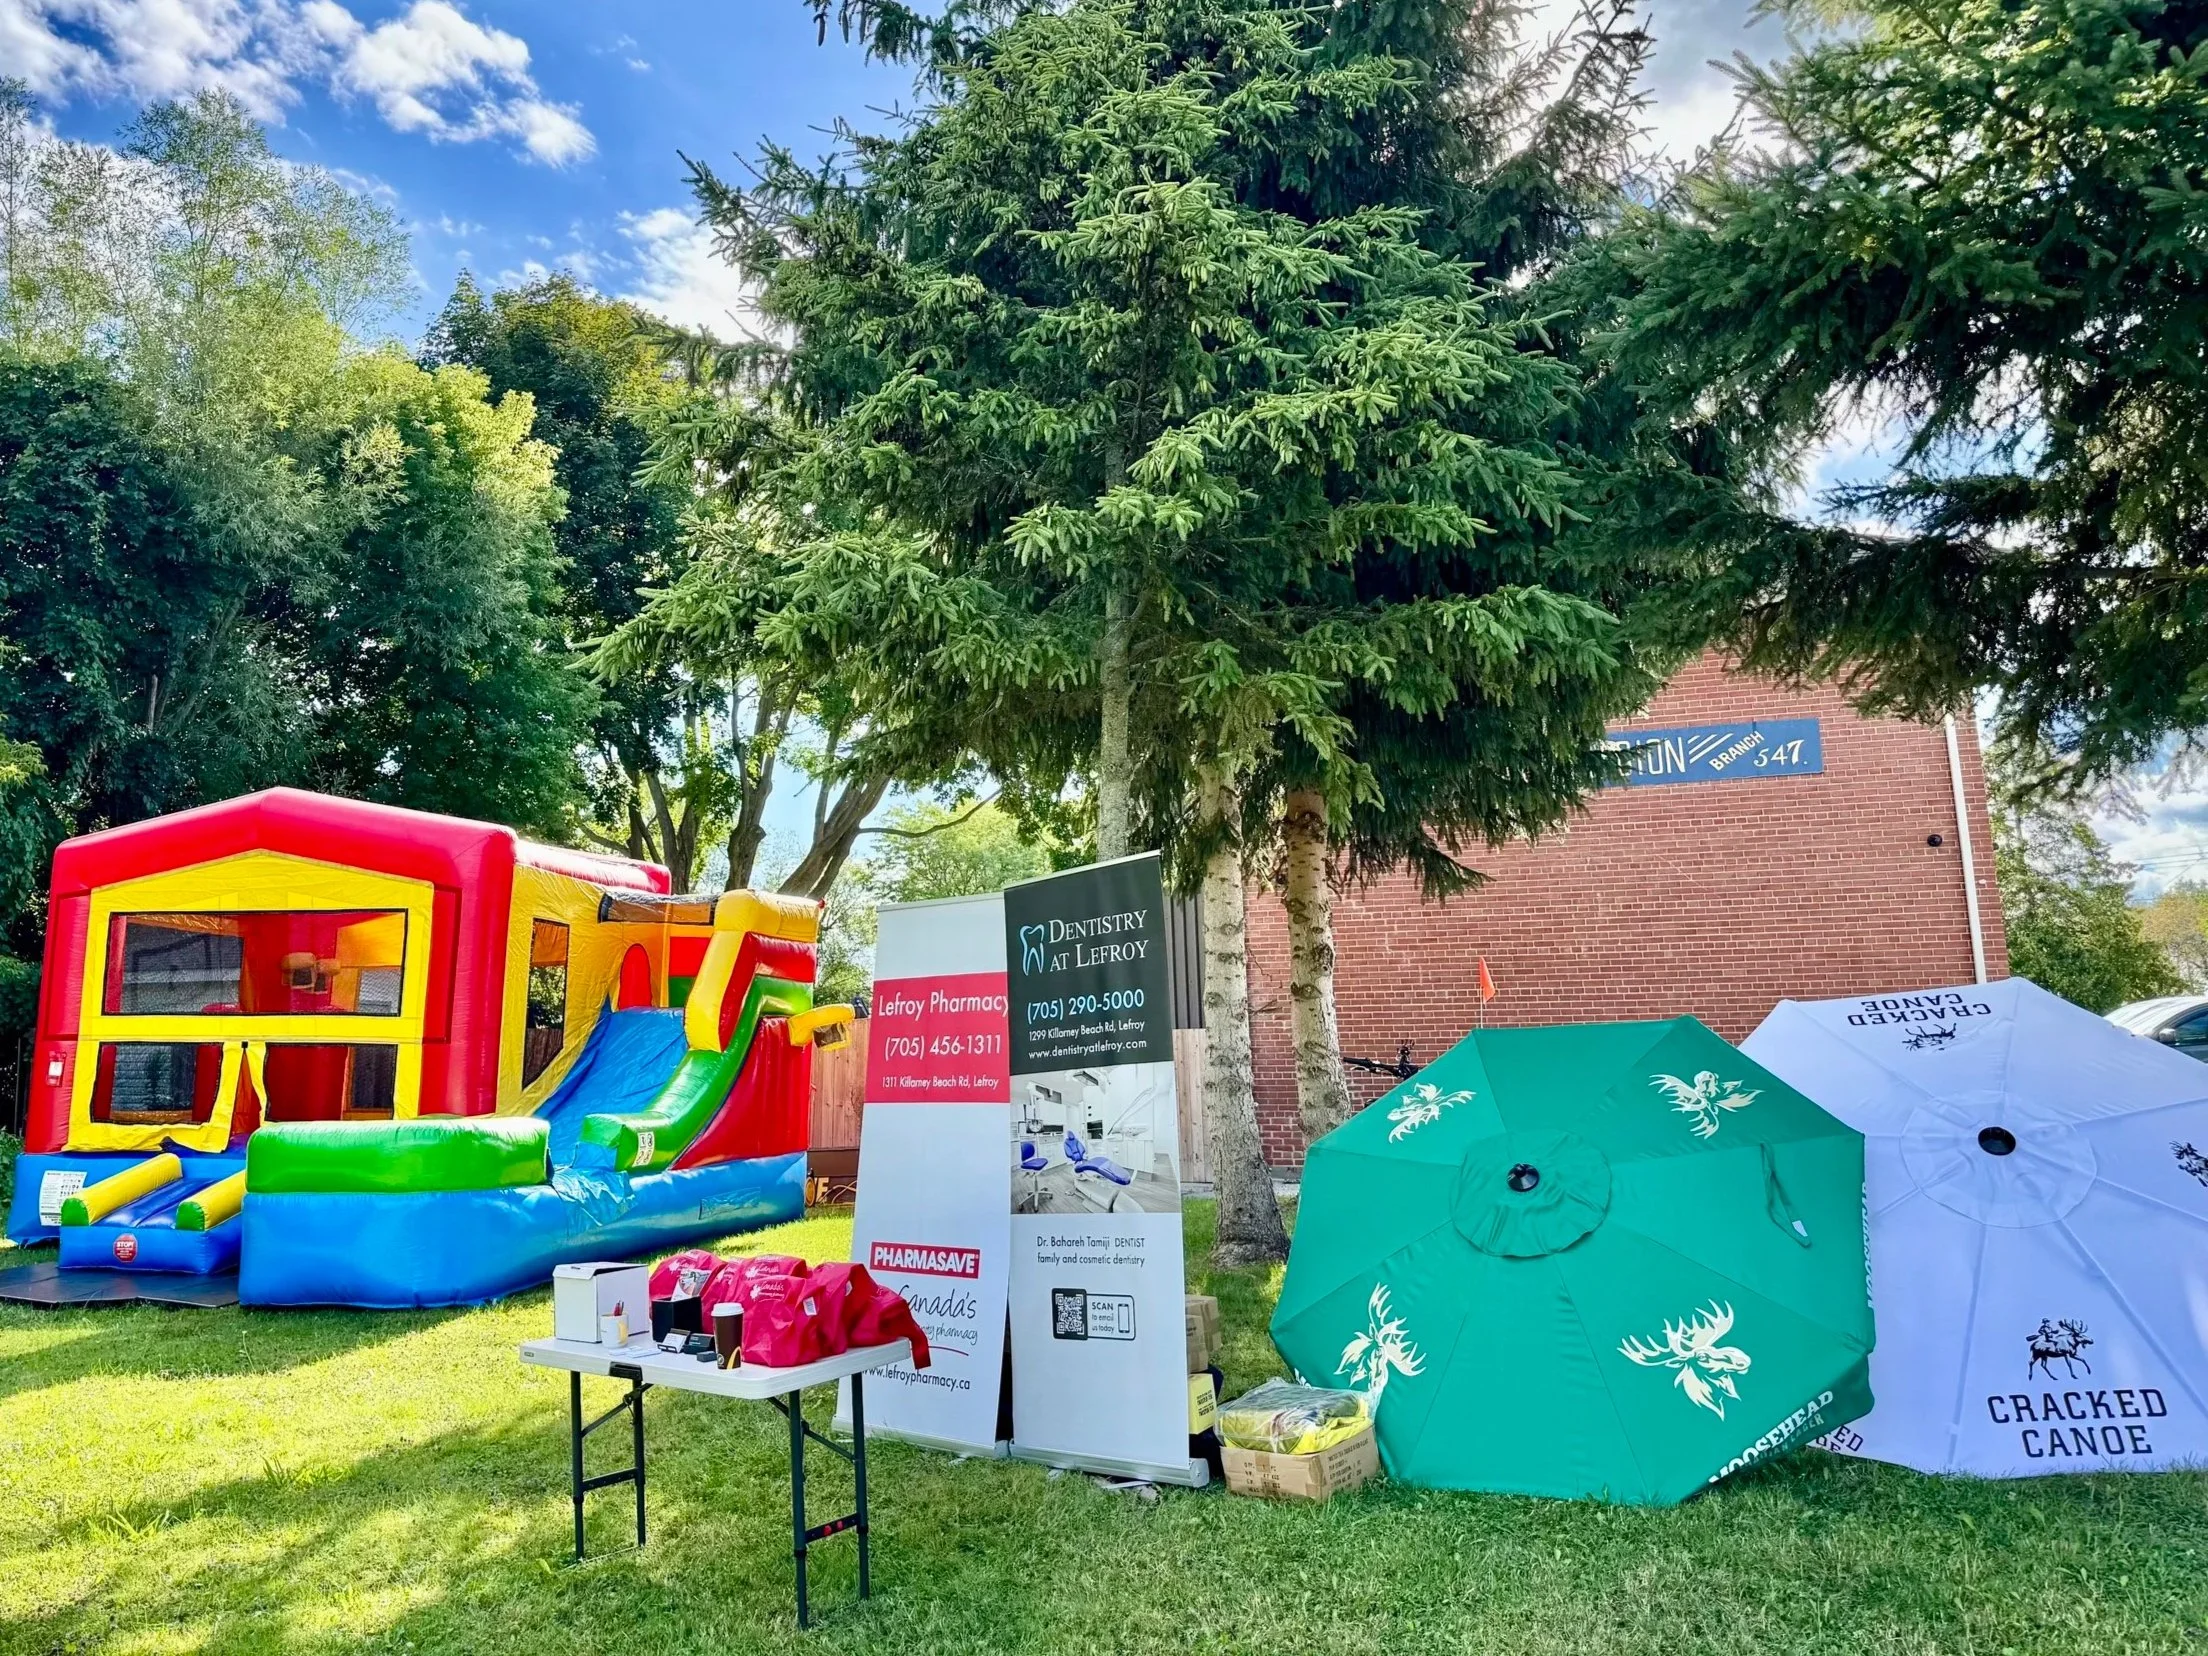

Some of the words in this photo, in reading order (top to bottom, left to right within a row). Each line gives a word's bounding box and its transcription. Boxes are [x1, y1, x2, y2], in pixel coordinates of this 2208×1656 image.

[1708, 730, 1765, 772] BRANCH
[878, 992, 926, 1022] Lefroy
[929, 989, 1009, 1018] Pharmacy
[1027, 998, 1064, 1025] (705)
[1068, 988, 1145, 1016] 290-5000
[1860, 993, 1964, 1012] CANOE
[1847, 1003, 1992, 1026] CRACKED
[1029, 1030, 1046, 1042] 1299
[1048, 1026, 1080, 1042] Killarney
[1080, 1022, 1104, 1036] Beach
[1104, 1020, 1117, 1033] Rd,
[1118, 1018, 1146, 1032] Lefroy
[885, 1035, 925, 1062] (705)
[929, 1034, 1001, 1056] 456-1311
[1028, 1038, 1147, 1060] www.dentistryatlefroy.com
[882, 1076, 897, 1088] 1311
[932, 1075, 957, 1087] Beach
[973, 1074, 1000, 1089] Lefroy
[1036, 1236, 1049, 1247] Dr.
[1050, 1235, 1085, 1248] Bahareh
[1114, 1237, 1145, 1248] DENTIST
[873, 1246, 976, 1274] PHARMASAVE
[1037, 1252, 1061, 1266] family
[1062, 1253, 1077, 1264] and
[1079, 1254, 1111, 1265] cosmetic
[1113, 1253, 1145, 1268] dentistry
[1091, 1301, 1114, 1311] SCAN
[1091, 1313, 1098, 1321] to
[935, 1322, 978, 1346] pharmacy
[1098, 1323, 1115, 1334] today
[1986, 1388, 2168, 1424] CRACKED
[2021, 1424, 2153, 1458] CANOE
